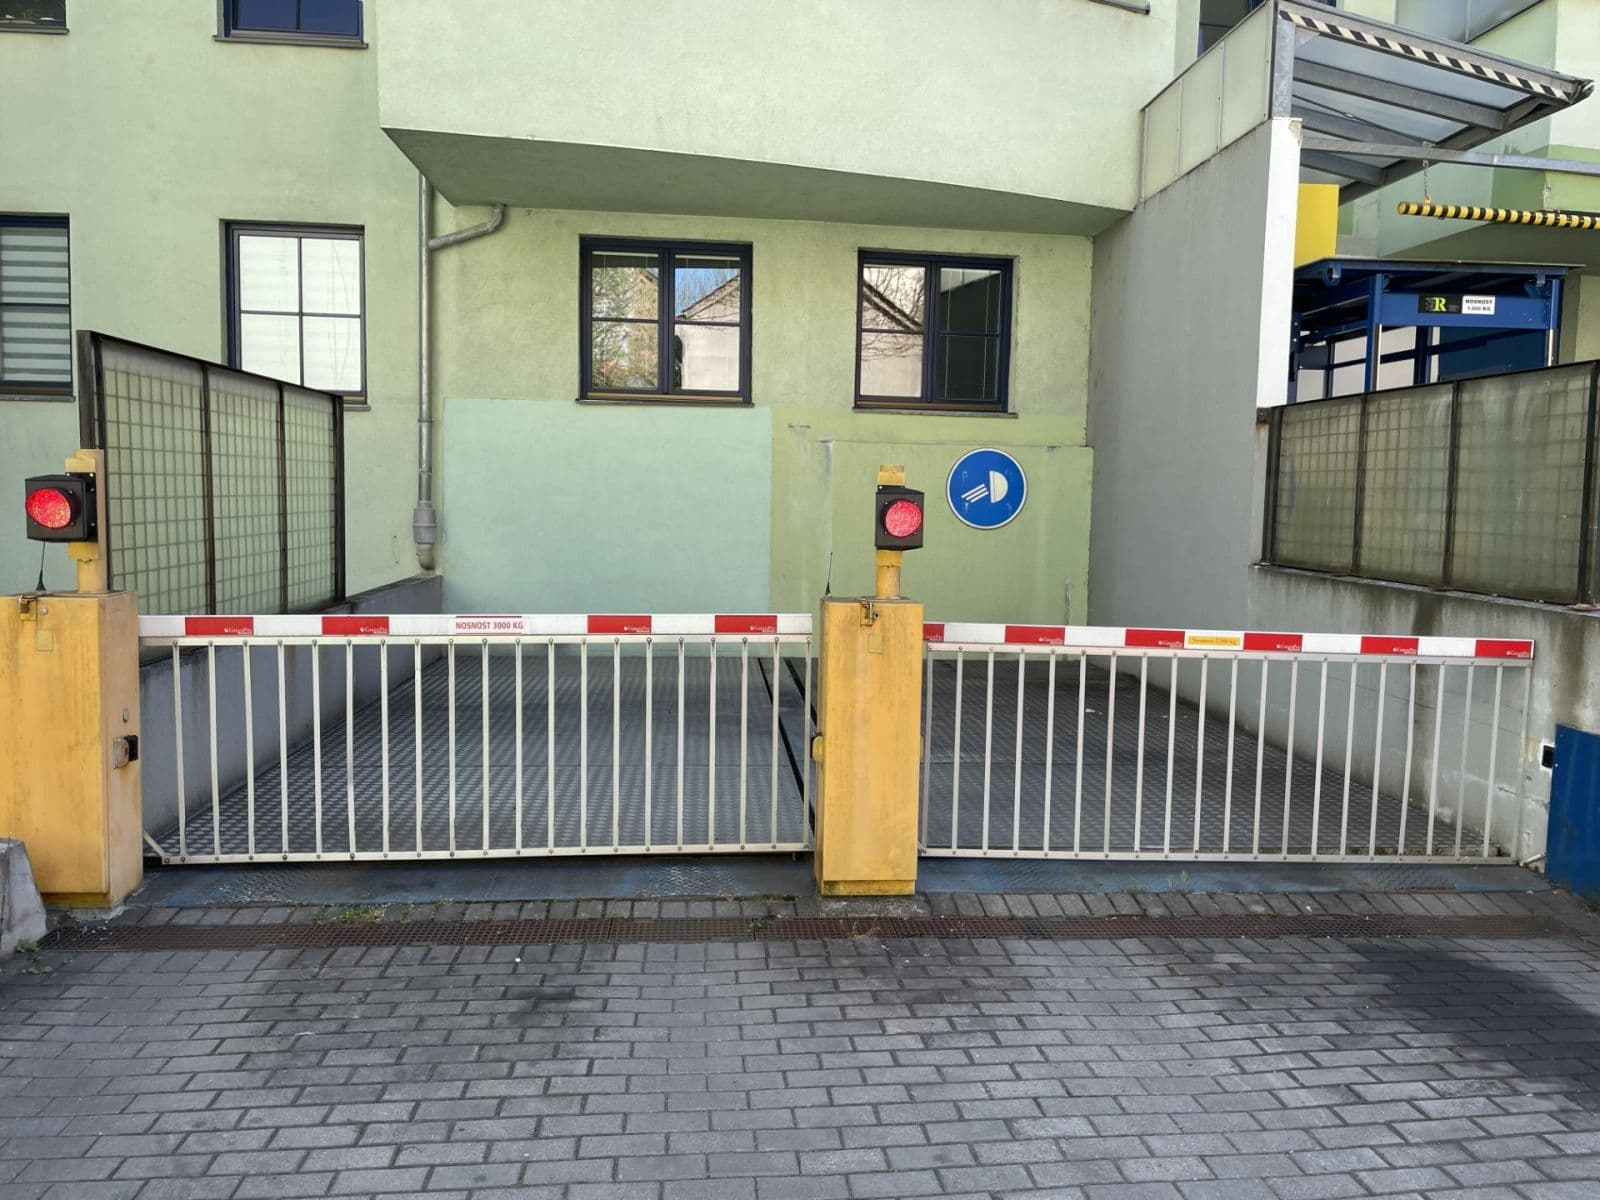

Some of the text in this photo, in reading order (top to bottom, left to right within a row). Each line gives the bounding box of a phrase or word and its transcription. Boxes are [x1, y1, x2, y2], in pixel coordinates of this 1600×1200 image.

[456, 621, 524, 629] NOSNOST 3000 KG
